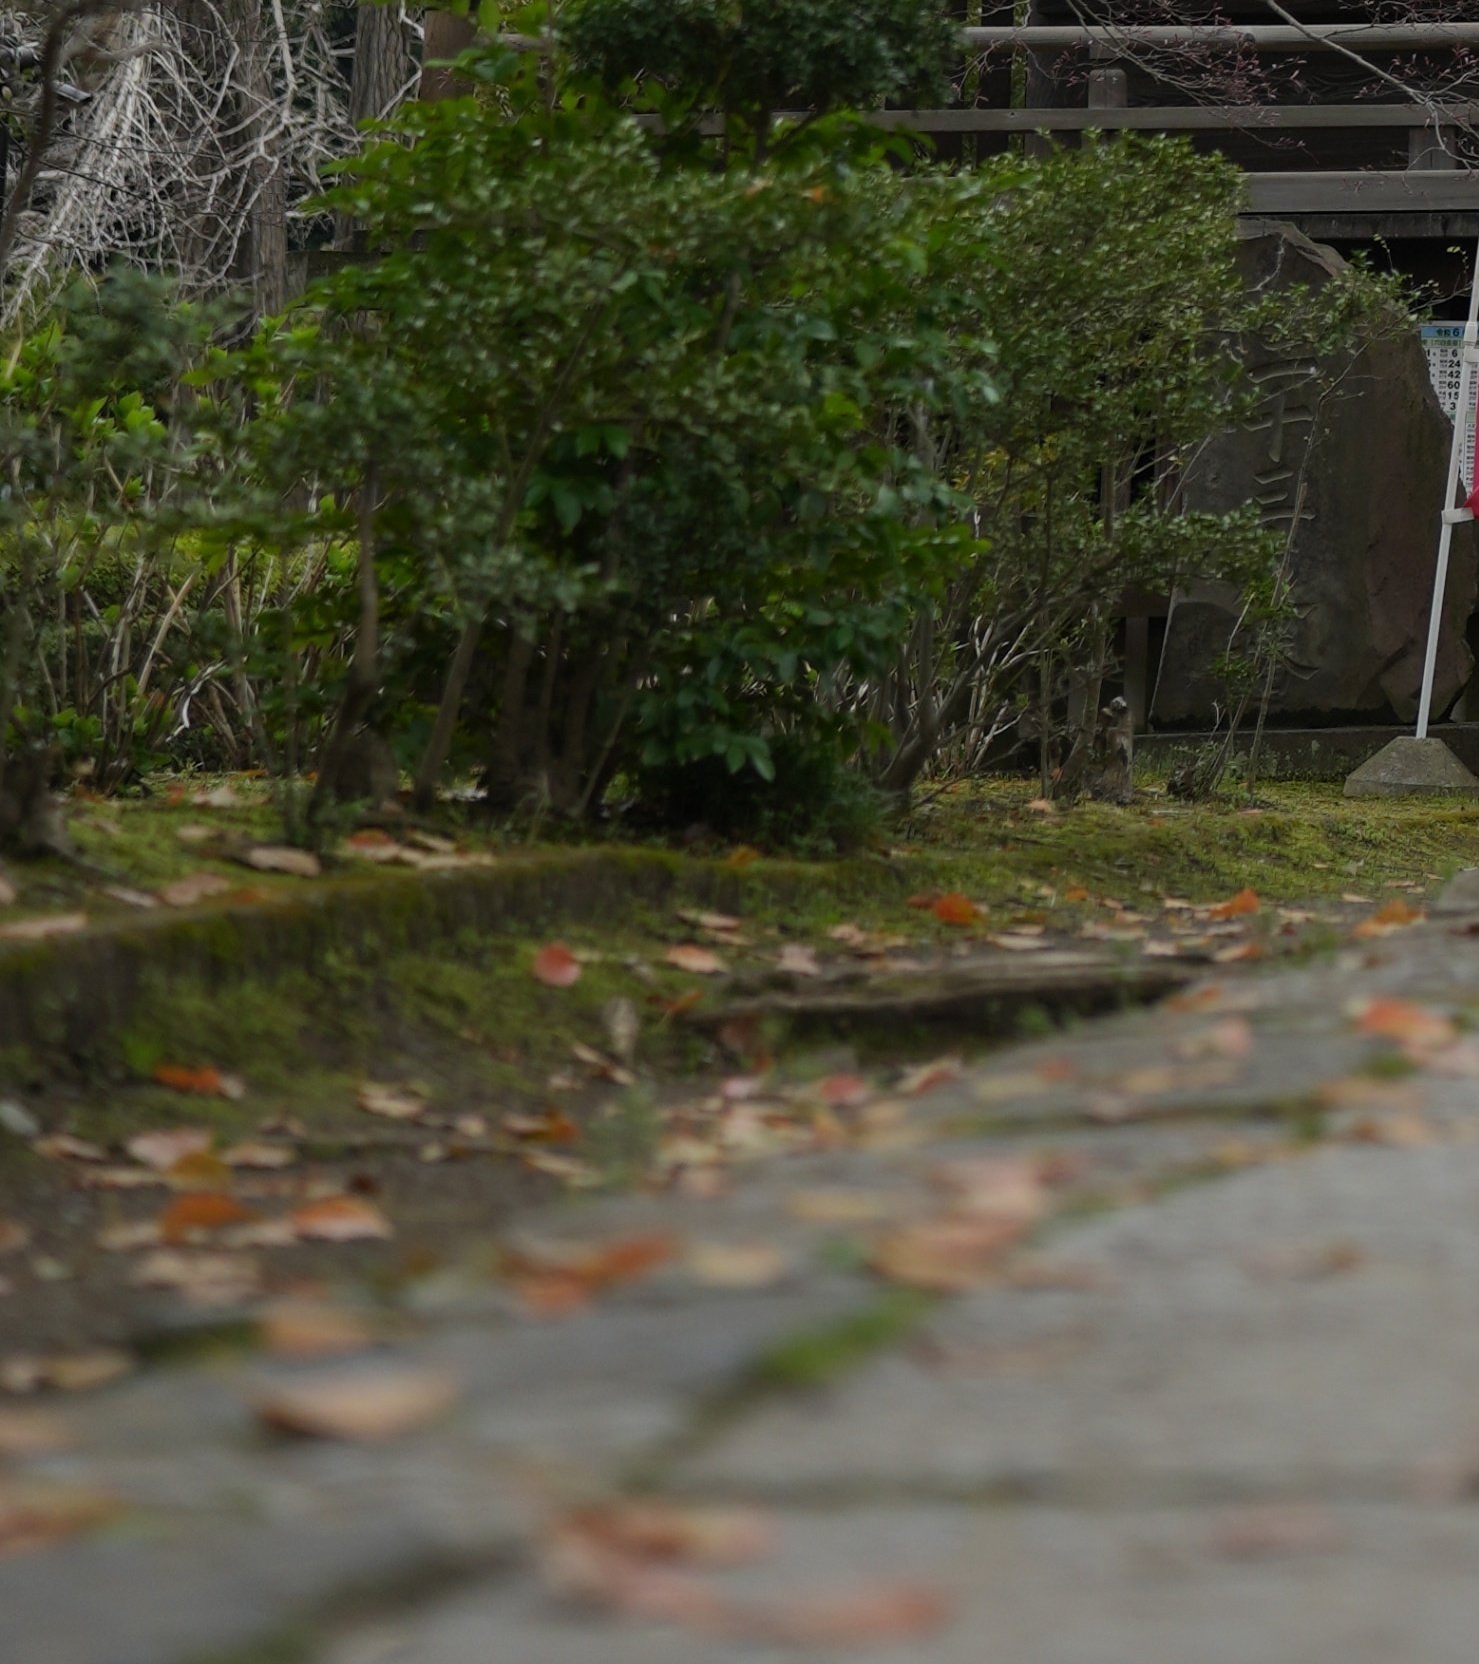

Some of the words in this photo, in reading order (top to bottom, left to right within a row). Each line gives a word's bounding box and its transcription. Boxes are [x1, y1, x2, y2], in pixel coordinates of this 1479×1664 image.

[1448, 360, 1460, 368] 24
[1448, 370, 1460, 378] 42
[1448, 381, 1460, 389] 60
[1448, 392, 1459, 400] 15
[1450, 402, 1456, 410] 3
